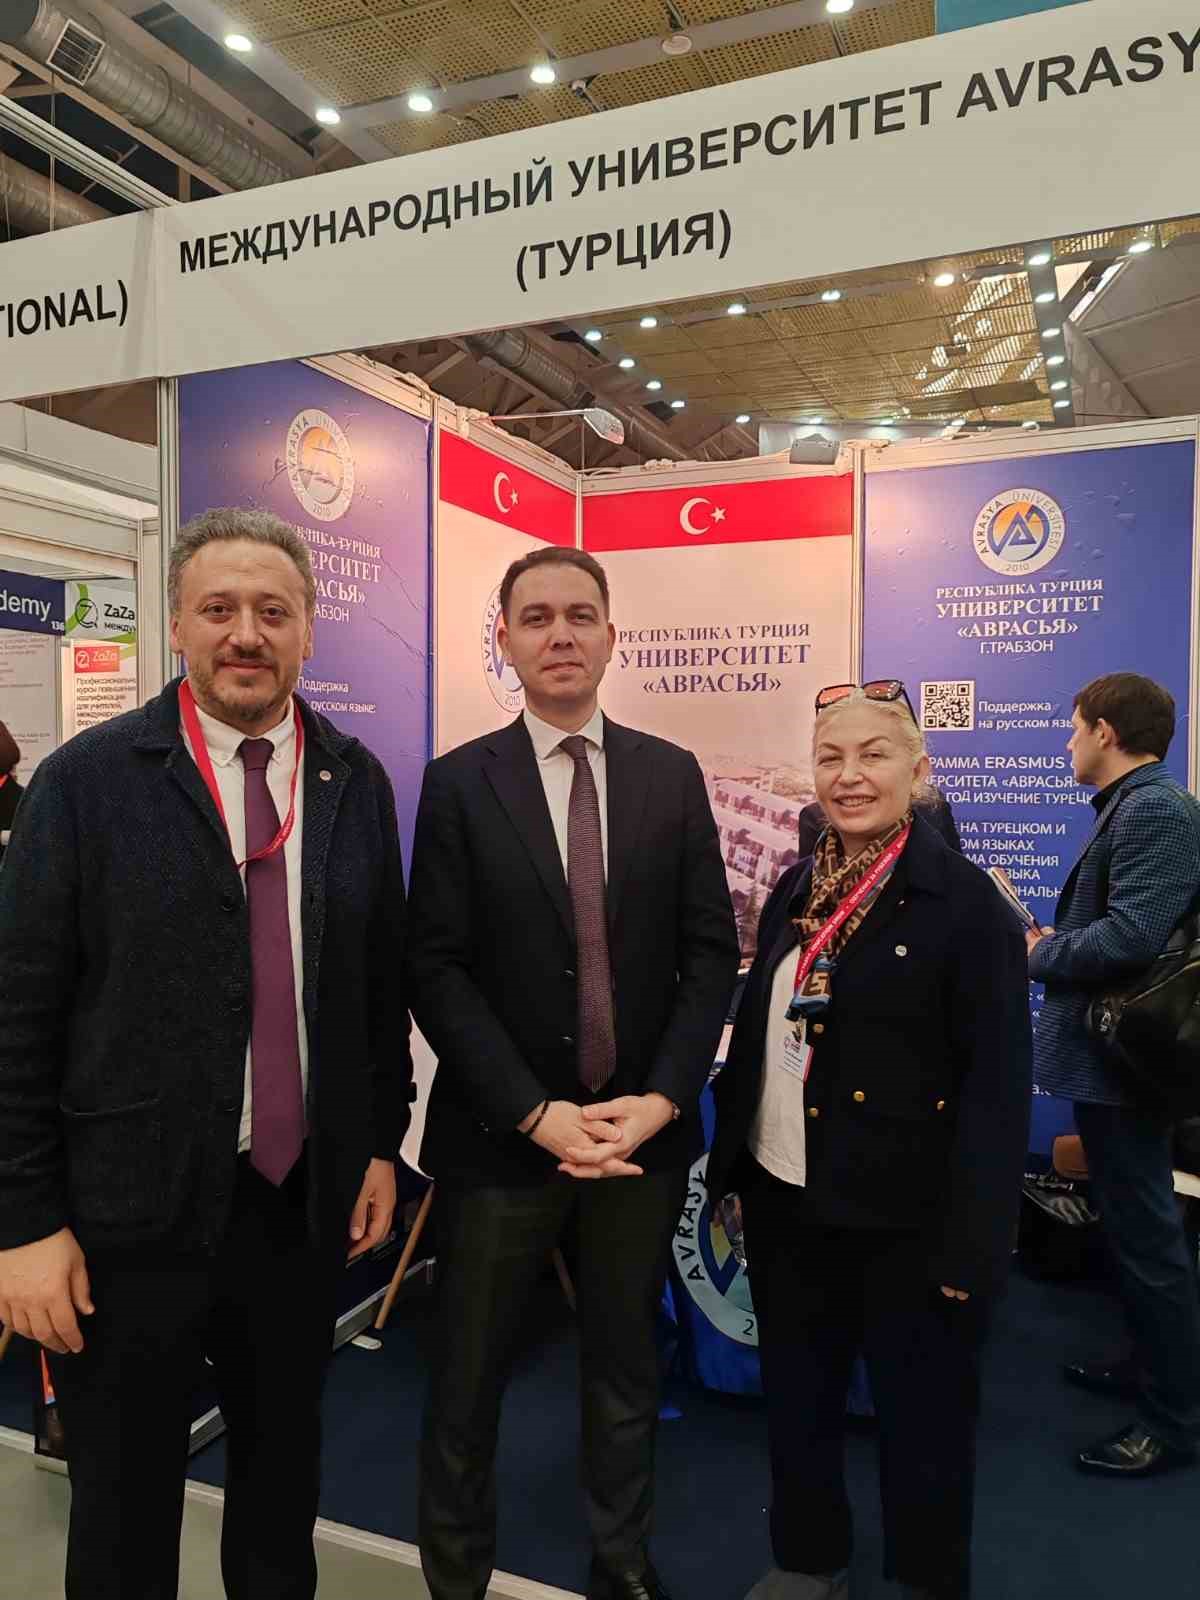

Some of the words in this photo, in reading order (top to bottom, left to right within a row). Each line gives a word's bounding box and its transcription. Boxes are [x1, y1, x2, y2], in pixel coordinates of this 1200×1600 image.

[180, 156, 553, 273] МЕЖДУНАРОДНЫЙ
[568, 81, 942, 197] УНИВЕРСИТЕТ
[956, 27, 1200, 118] AVRASY
[516, 209, 731, 292] (ТУРЦИЯ)
[0, 280, 128, 338] IONAL)
[936, 583, 1035, 599] РЕСПУБЛИКА
[1039, 579, 1103, 593] ТУРЦИЯ
[314, 603, 351, 623] АБЗОН
[936, 595, 1104, 618] УНИВЕРСИТЕТ
[484, 595, 500, 673] AVRASY
[619, 627, 732, 643] РЕСПУБЛИКА
[737, 623, 809, 640] ТУРЦИЯ
[957, 618, 1079, 638] «АВРАСЬЯ»
[618, 644, 811, 668] УНИВЕРСИТЕТ
[980, 639, 1053, 654] Г.ТРАБЗОН
[298, 676, 349, 694] Поддержка
[643, 672, 781, 694] «АВРАСЬЯ»
[978, 701, 1051, 715] Поддержка
[978, 720, 993, 728] на
[996, 719, 1049, 731] русском
[985, 756, 1065, 769] ERASMUS
[974, 792, 1040, 804] ИЗУЧЕНИЕ
[960, 822, 978, 833] НА
[982, 822, 1052, 835] ТУРЕЦКОМ
[1055, 823, 1066, 834] И
[982, 838, 1034, 851] ЯЗЫКАХ
[988, 854, 1059, 866] ОБУЧЕНИЯ
[677, 1171, 706, 1281] AVRASY
[742, 1319, 754, 1336] 2
